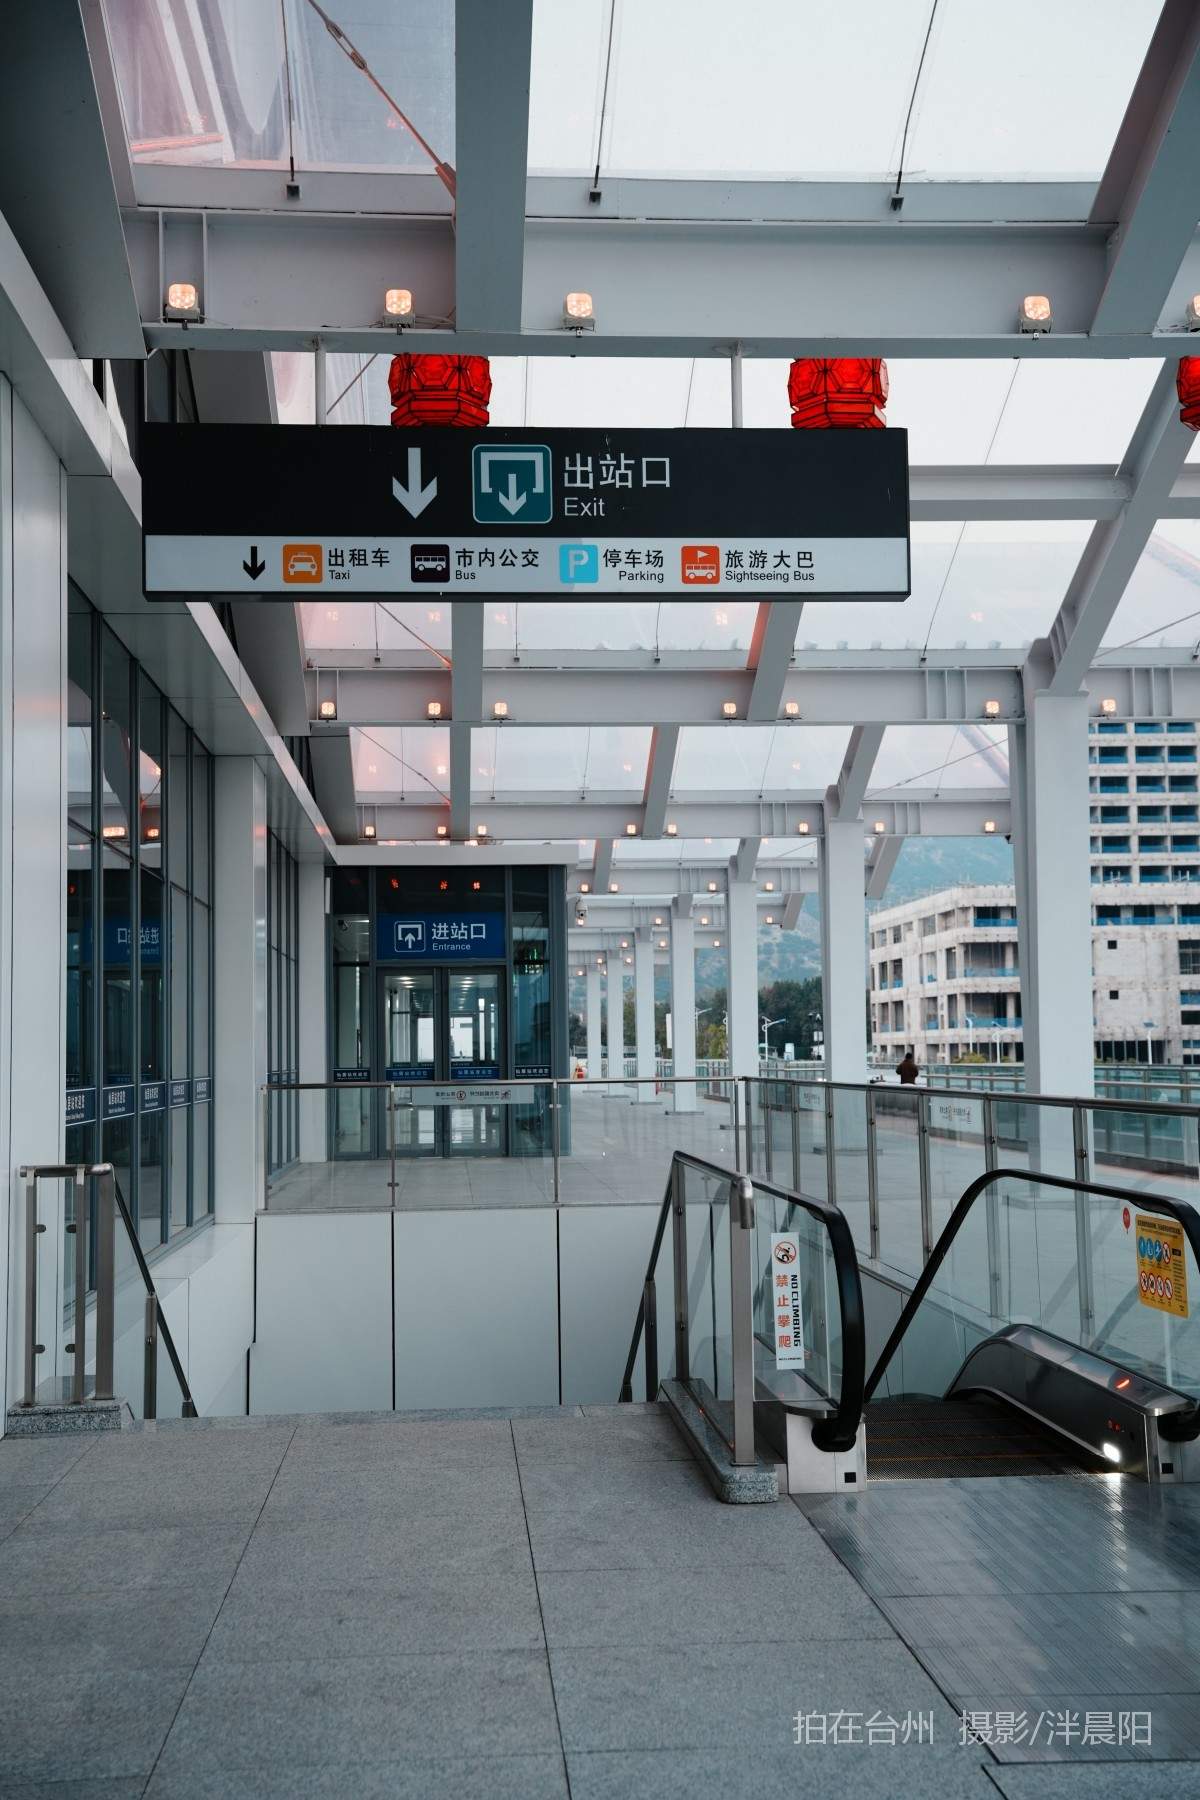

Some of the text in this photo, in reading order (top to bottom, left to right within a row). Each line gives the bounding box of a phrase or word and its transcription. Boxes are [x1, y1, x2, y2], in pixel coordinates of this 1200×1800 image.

[563, 453, 671, 489] 出站口
[564, 497, 605, 517] Exit
[328, 548, 390, 567] 出租车
[455, 548, 540, 568] 市内公交
[603, 549, 664, 569] 停车场
[725, 550, 814, 569] 旅游大巴
[329, 569, 350, 580] Taxi
[455, 570, 476, 580] Bus
[618, 571, 664, 583] Parking
[725, 570, 815, 583] Sightseeing Bus
[431, 922, 486, 940] 进站口
[432, 943, 471, 951] Entrance
[776, 1274, 791, 1348] 禁止攀爬
[791, 1274, 801, 1347] NO CLIMBING
